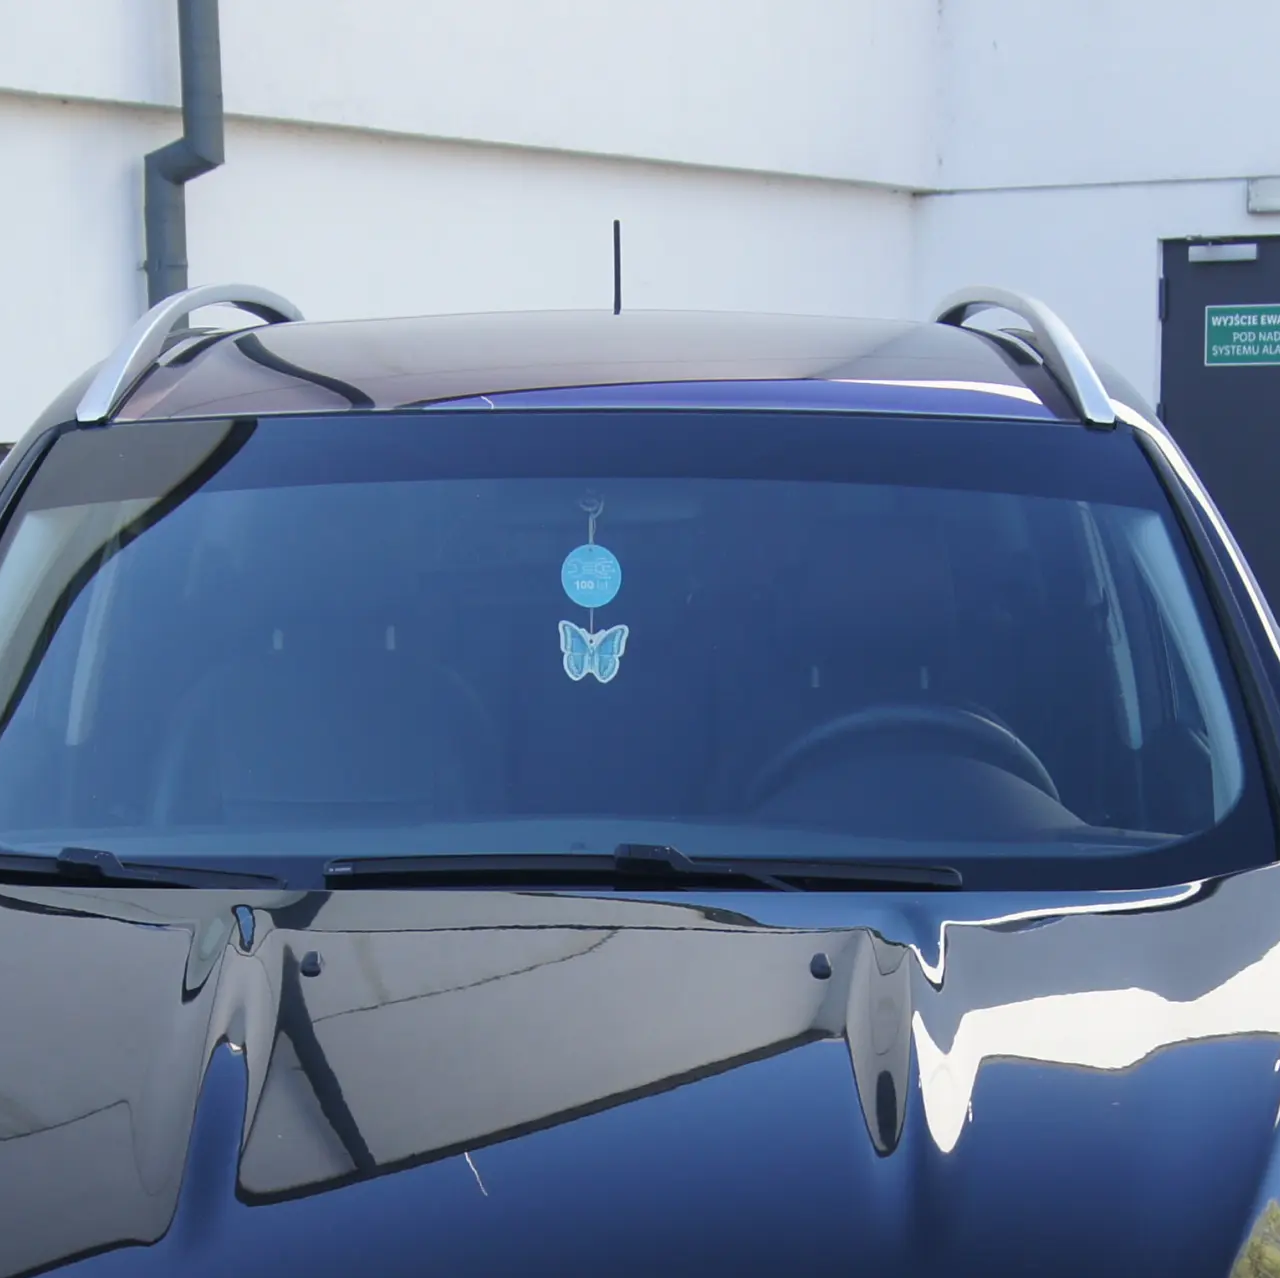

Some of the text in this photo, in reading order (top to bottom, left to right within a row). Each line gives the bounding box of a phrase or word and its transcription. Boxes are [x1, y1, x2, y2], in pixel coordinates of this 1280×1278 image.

[1211, 313, 1258, 326] WYJŚCIE
[1232, 331, 1256, 343] POD
[1212, 345, 1259, 356] SYSTEMU
